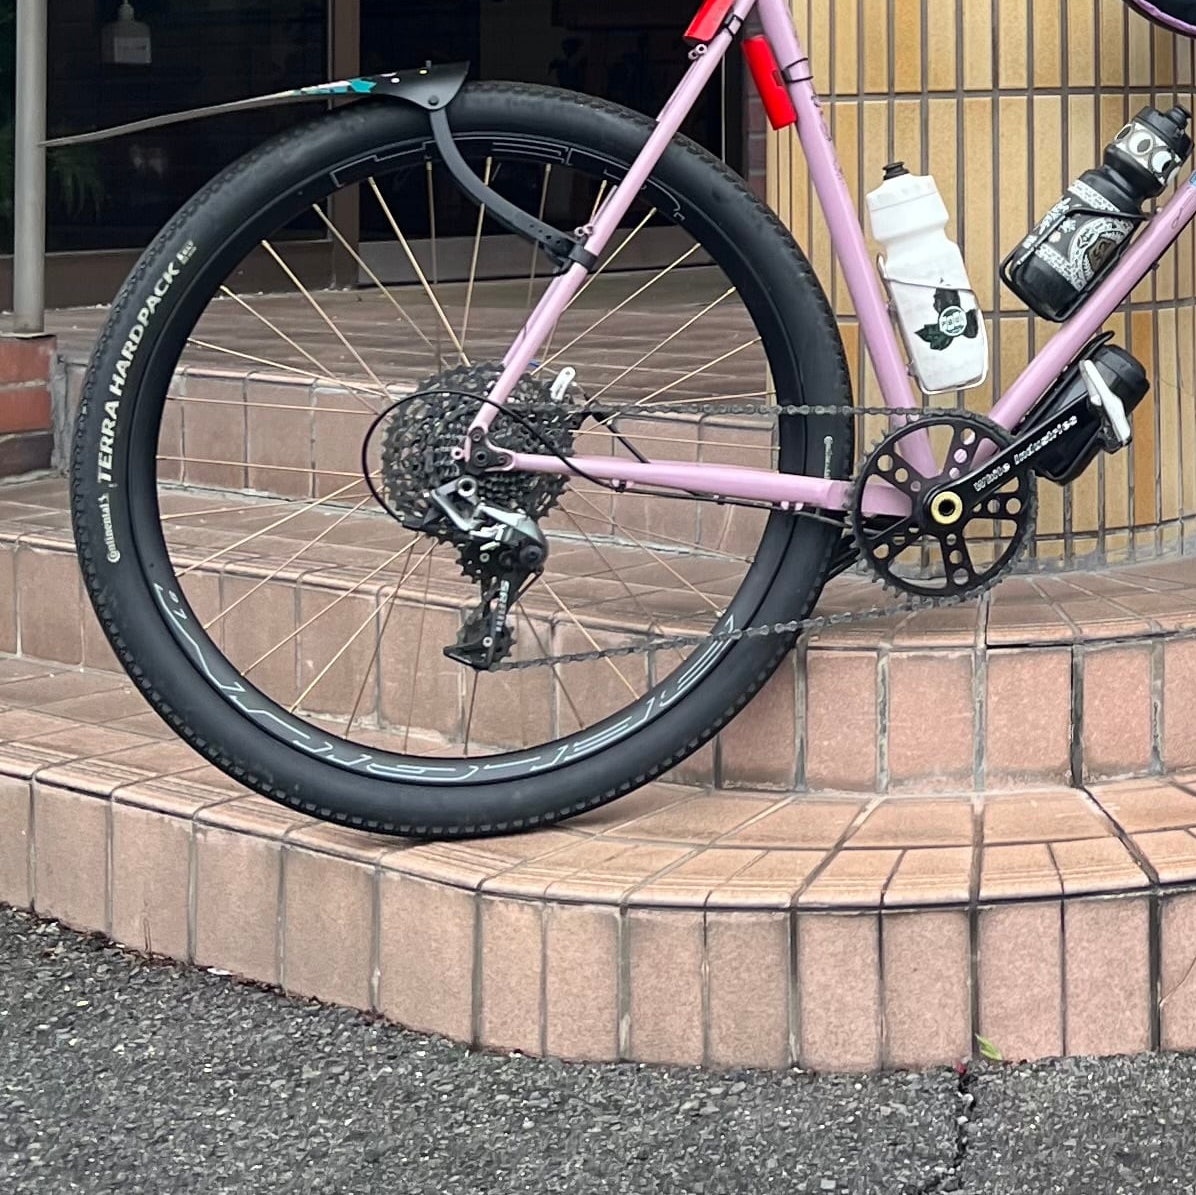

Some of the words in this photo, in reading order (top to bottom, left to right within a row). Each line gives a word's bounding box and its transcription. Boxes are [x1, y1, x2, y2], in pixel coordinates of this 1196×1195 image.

[109, 261, 180, 396] HARDPACK
[97, 400, 120, 484] TERRA
[99, 501, 121, 564] Continental
